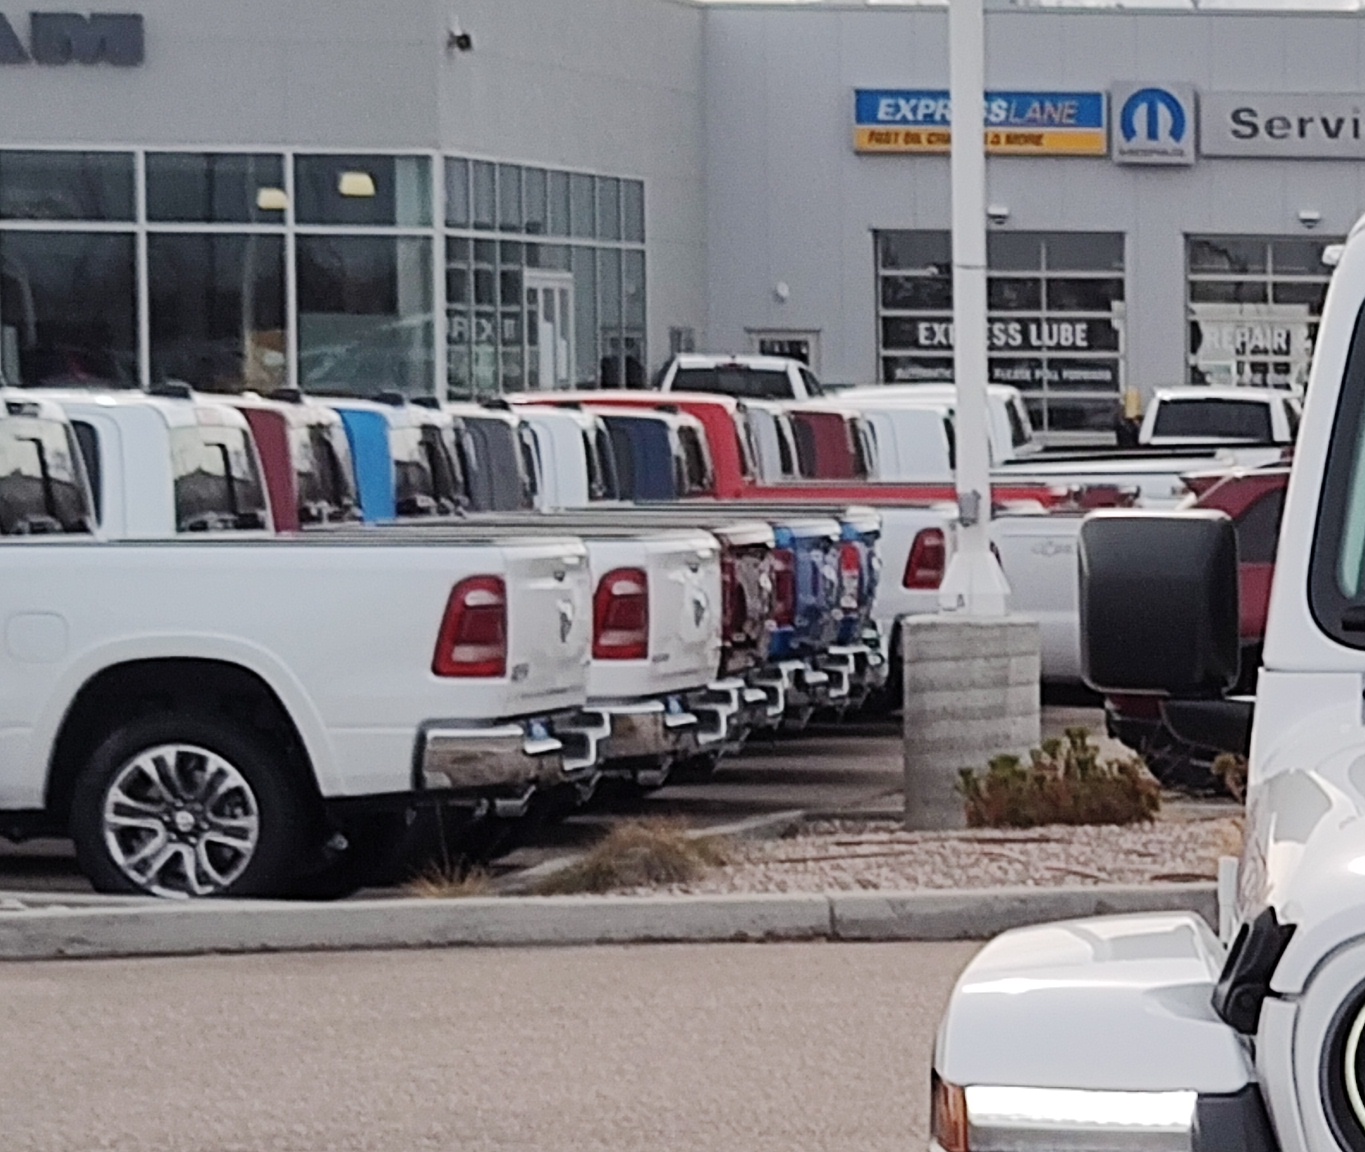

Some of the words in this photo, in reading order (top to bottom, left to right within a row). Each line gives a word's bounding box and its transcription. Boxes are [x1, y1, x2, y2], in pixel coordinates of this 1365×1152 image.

[1005, 132, 1045, 147] MORE
[917, 321, 1023, 347] EXSS
[1029, 322, 1089, 348] LUBE
